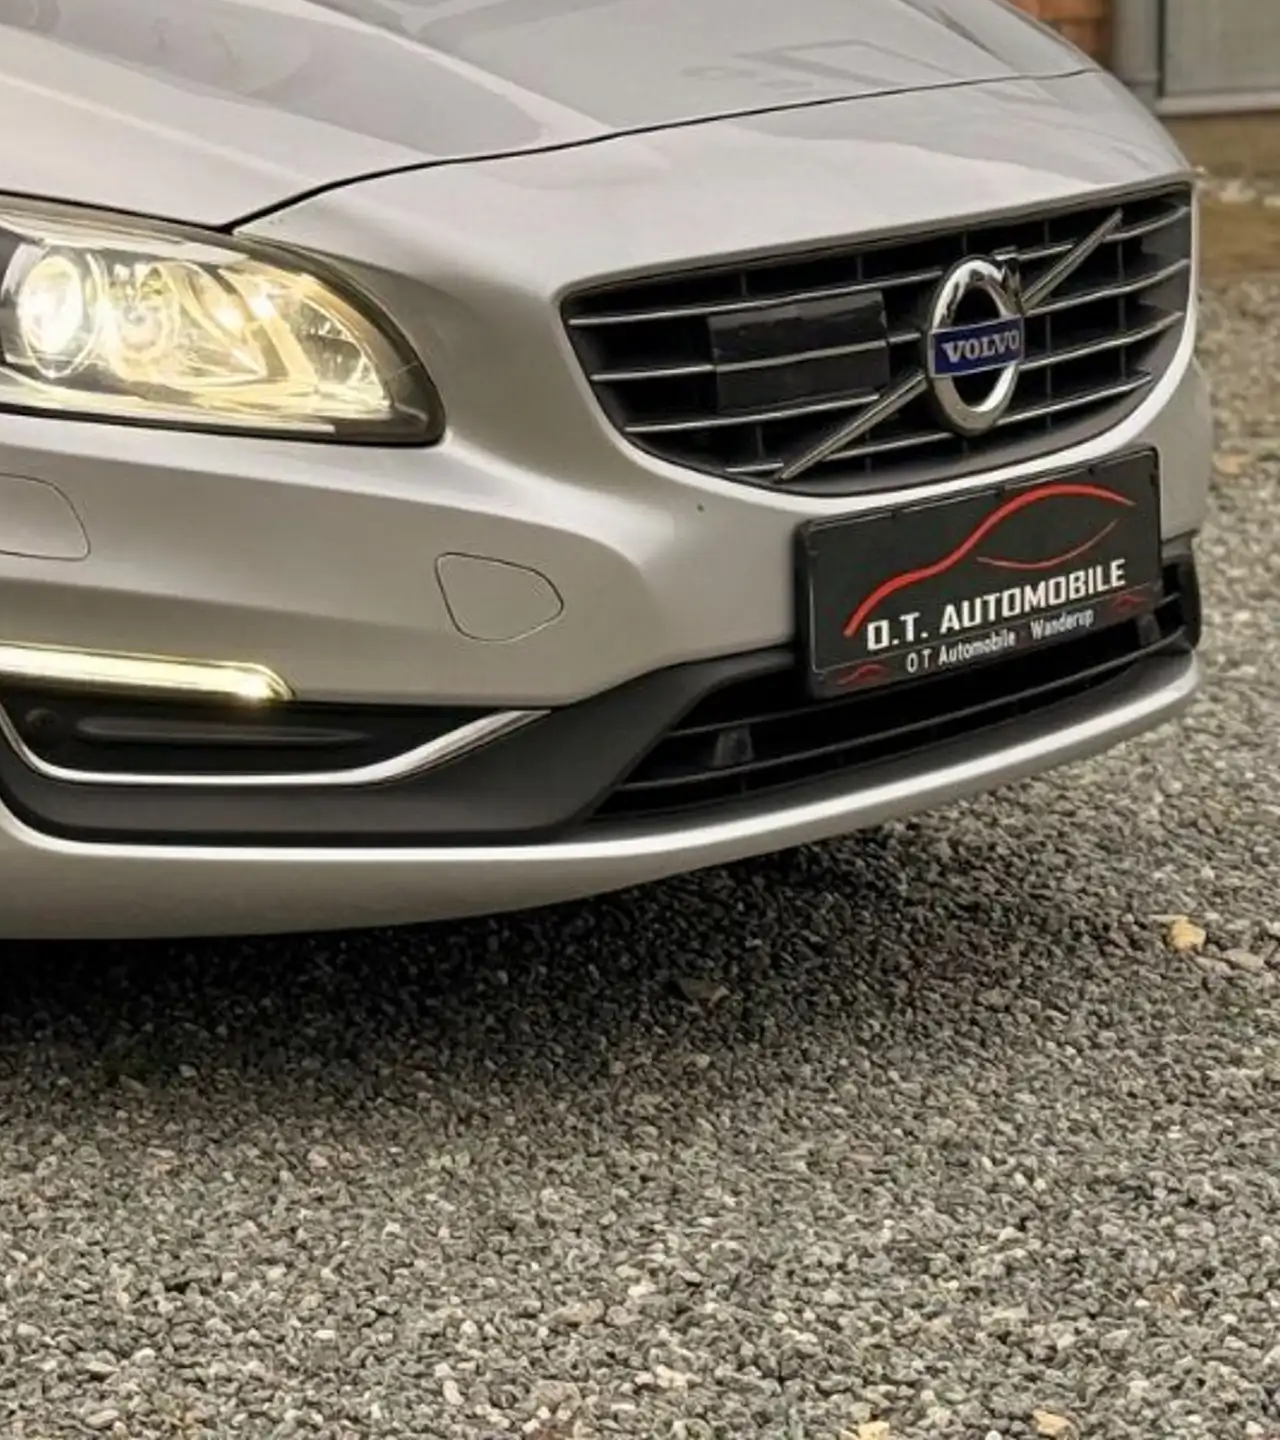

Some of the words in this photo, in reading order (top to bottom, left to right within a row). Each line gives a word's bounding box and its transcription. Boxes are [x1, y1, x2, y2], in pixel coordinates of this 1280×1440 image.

[941, 329, 1020, 364] VOLVO
[866, 611, 929, 651] O.T.
[940, 558, 1127, 635] AUTOMOBILE
[939, 628, 1017, 666] Automobile
[1029, 608, 1096, 641] Wanderup
